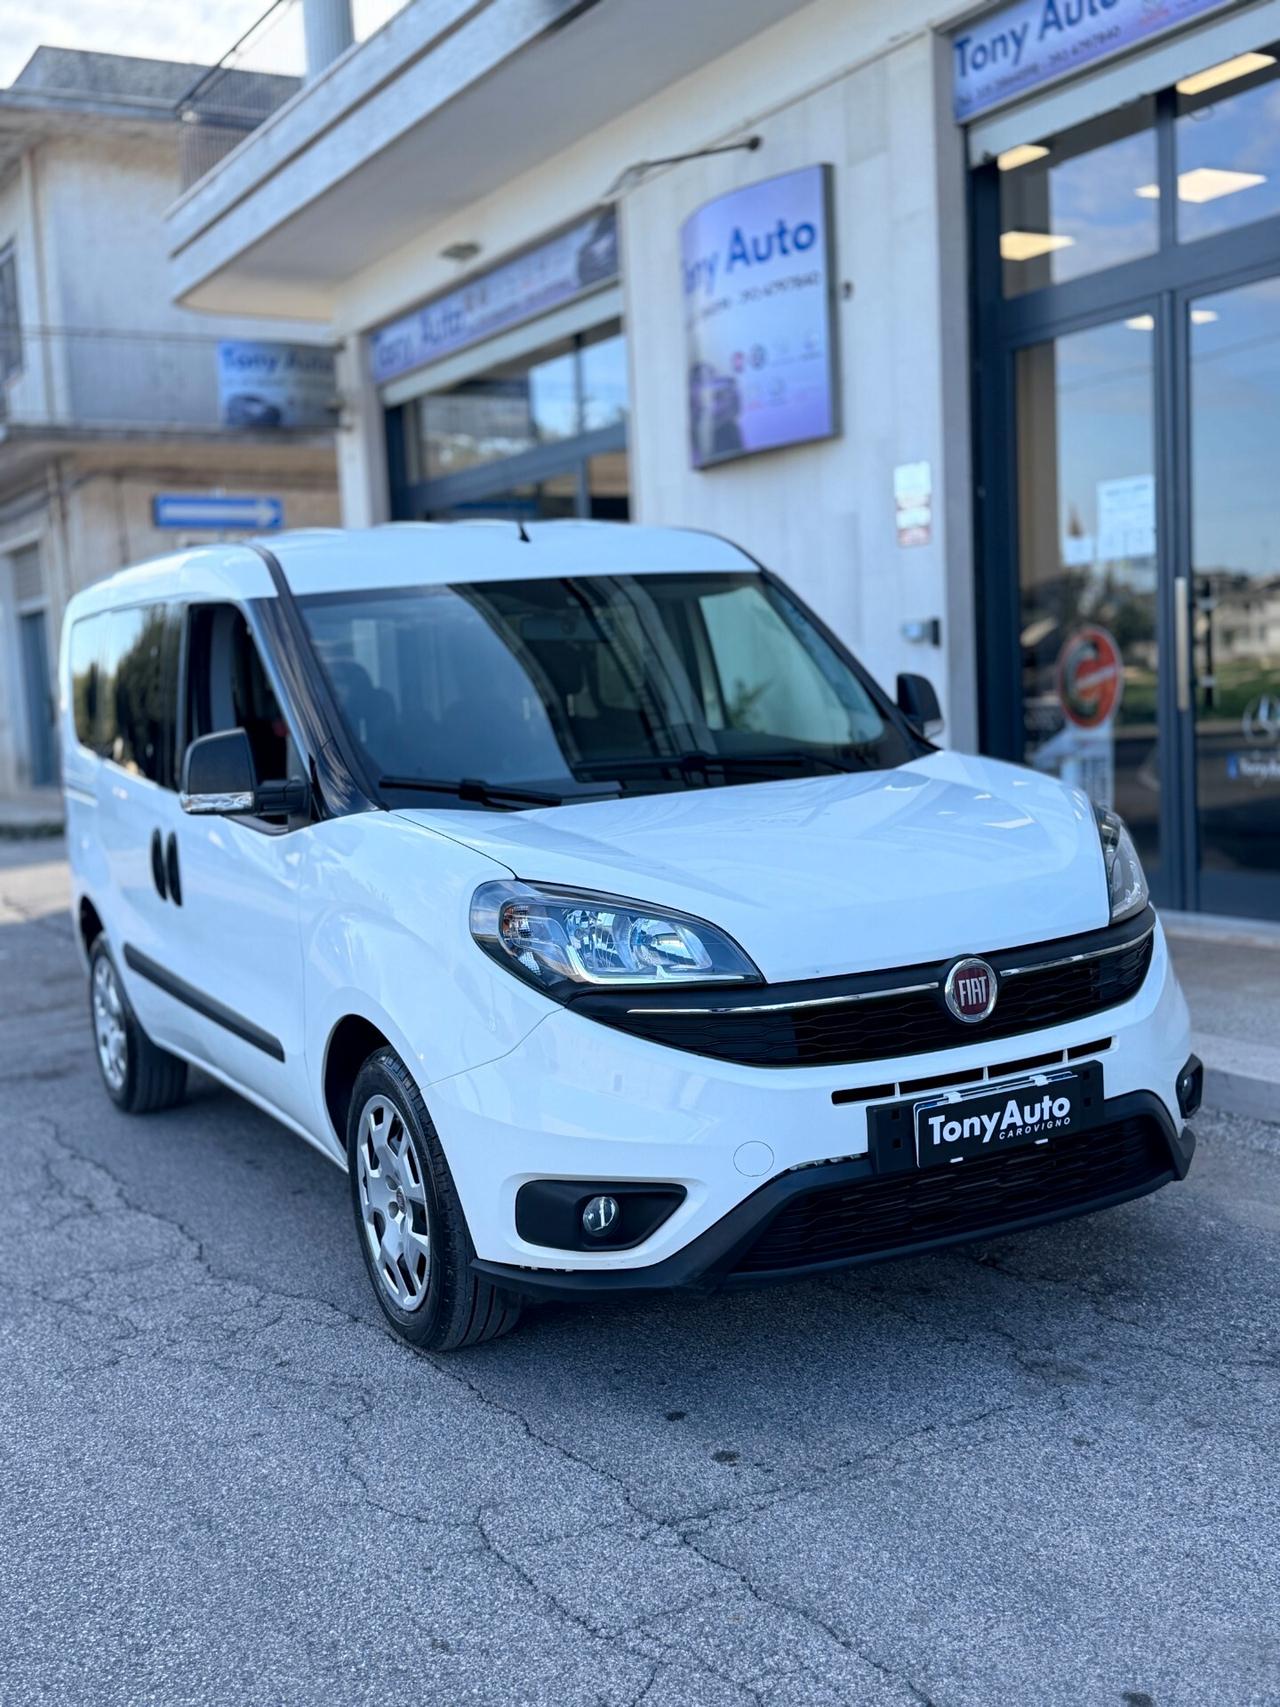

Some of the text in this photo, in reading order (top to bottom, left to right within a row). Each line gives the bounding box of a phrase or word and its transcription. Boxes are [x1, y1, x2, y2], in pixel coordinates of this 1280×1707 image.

[953, 22, 1029, 78] Tony
[1036, 0, 1119, 42] Au
[726, 218, 816, 274] Auto
[222, 344, 278, 374] Tony
[958, 976, 987, 1007] FIAT
[928, 1095, 1071, 1145] TonyAuto
[999, 1118, 1071, 1140] CAROVIGNO
